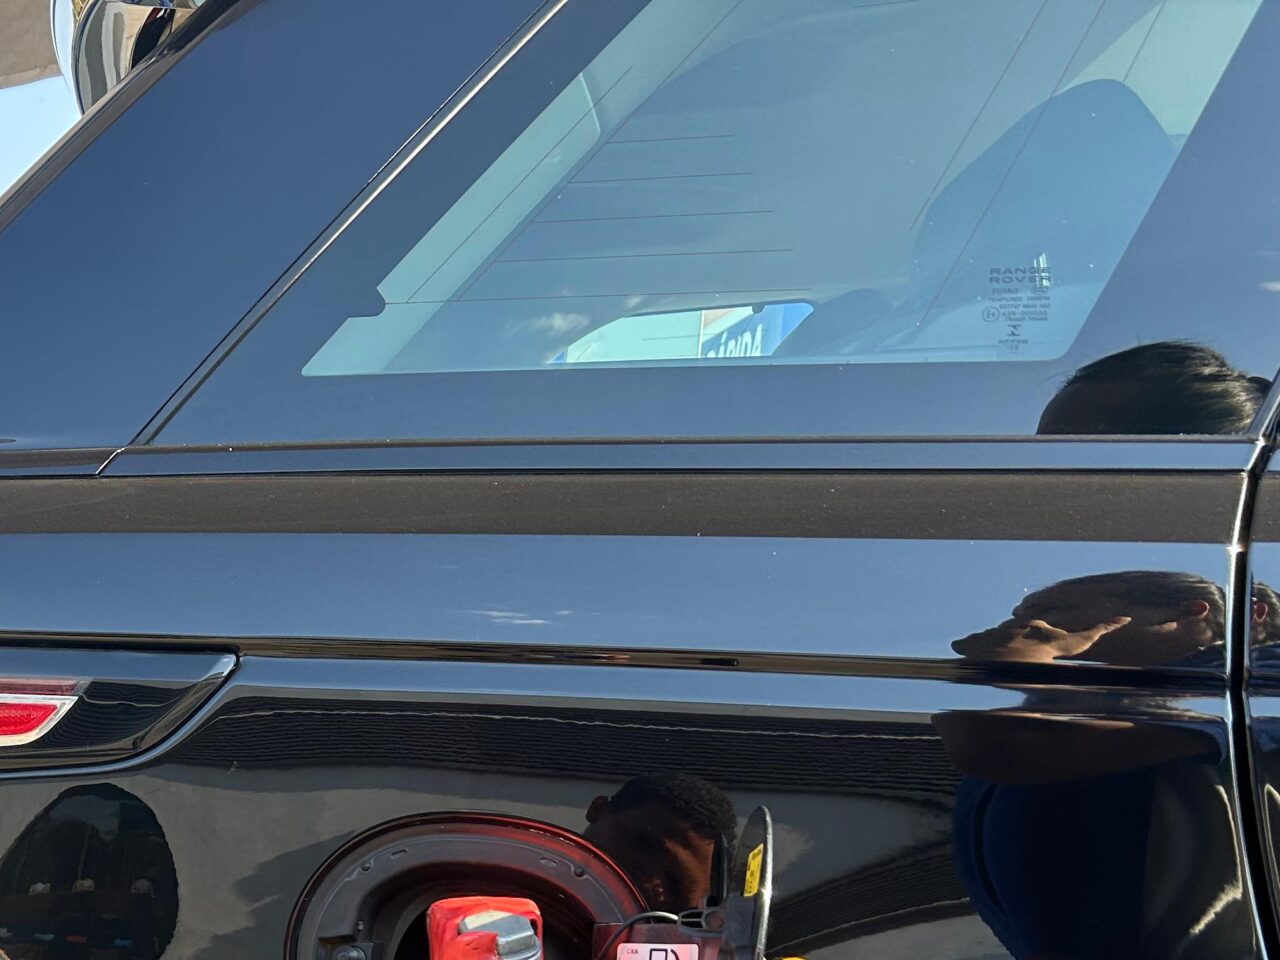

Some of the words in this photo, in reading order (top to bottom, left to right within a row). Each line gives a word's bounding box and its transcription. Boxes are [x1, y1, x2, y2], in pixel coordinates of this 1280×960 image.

[989, 267, 1051, 275] RANGE
[988, 276, 1051, 285] ROVER
[707, 323, 762, 358] ÁPIDA
